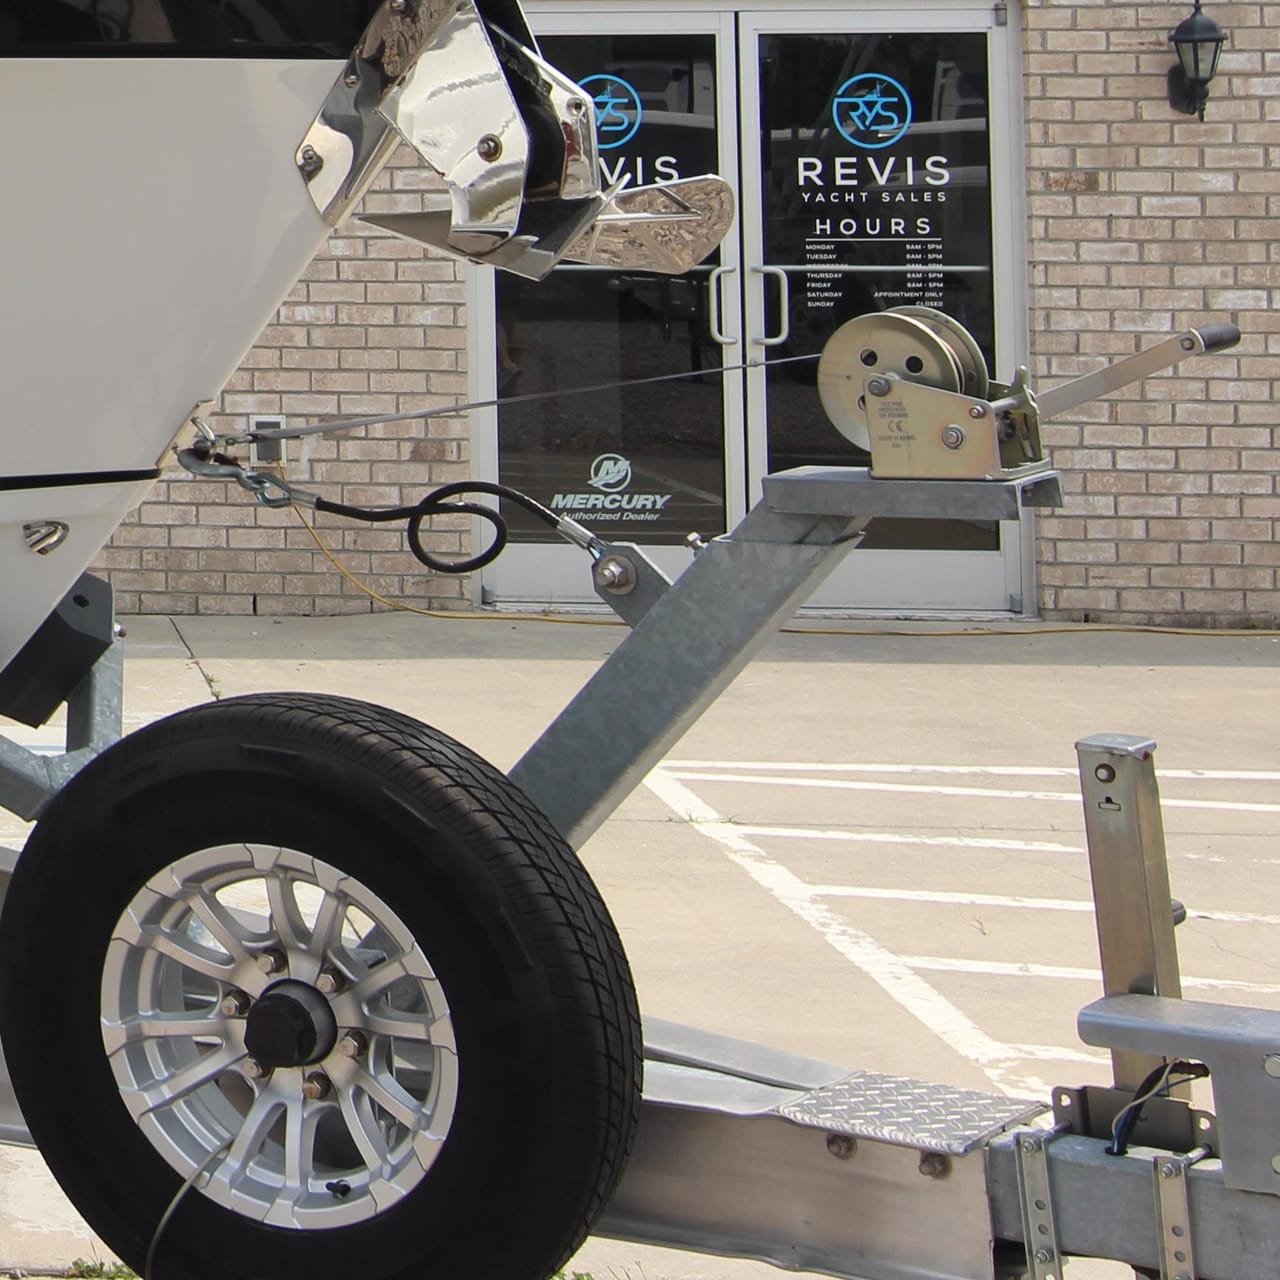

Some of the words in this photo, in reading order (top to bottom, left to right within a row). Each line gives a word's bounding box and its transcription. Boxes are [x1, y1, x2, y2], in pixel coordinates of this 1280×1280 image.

[797, 156, 951, 187] REVIS
[801, 192, 869, 203] YACHT
[881, 192, 947, 203] SALES
[815, 218, 931, 235] HOURS
[550, 493, 672, 510] MERCURY
[560, 511, 621, 521] Authorized
[622, 511, 660, 521] Dealer
